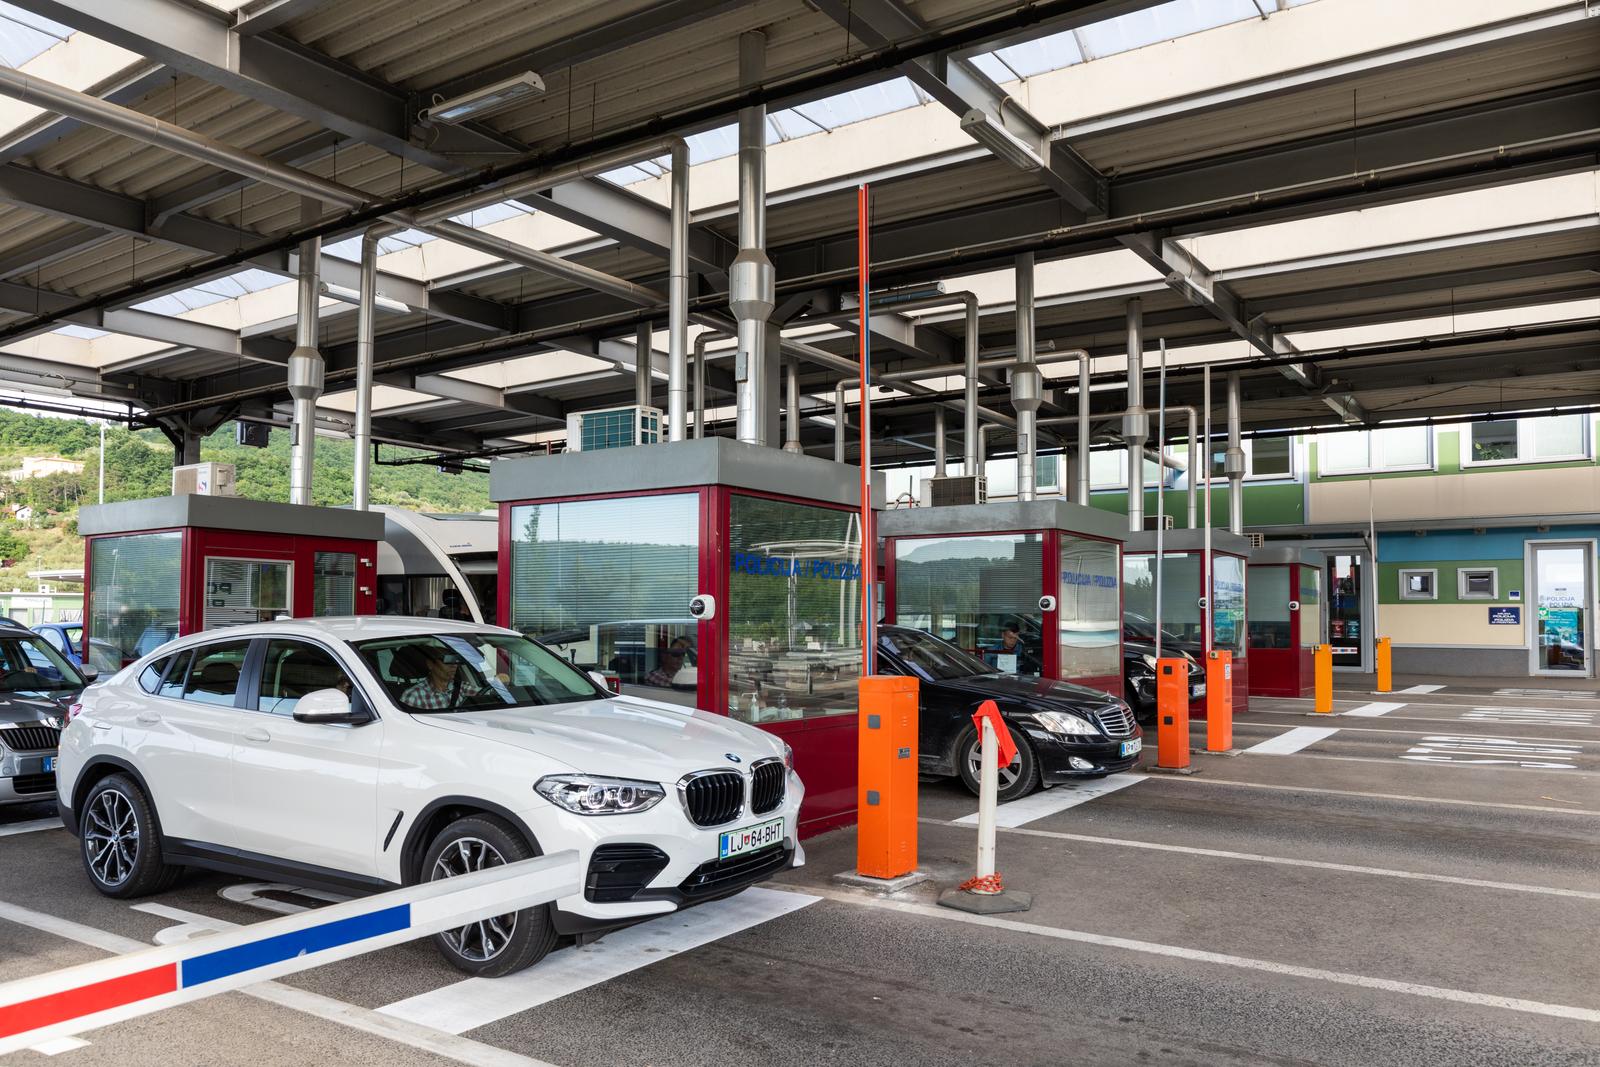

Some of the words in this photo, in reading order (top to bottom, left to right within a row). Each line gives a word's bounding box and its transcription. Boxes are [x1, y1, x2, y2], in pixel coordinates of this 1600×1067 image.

[735, 552, 802, 577] POLICIJA
[813, 560, 861, 580] POLIZIA
[1399, 736, 1583, 769] STOP
